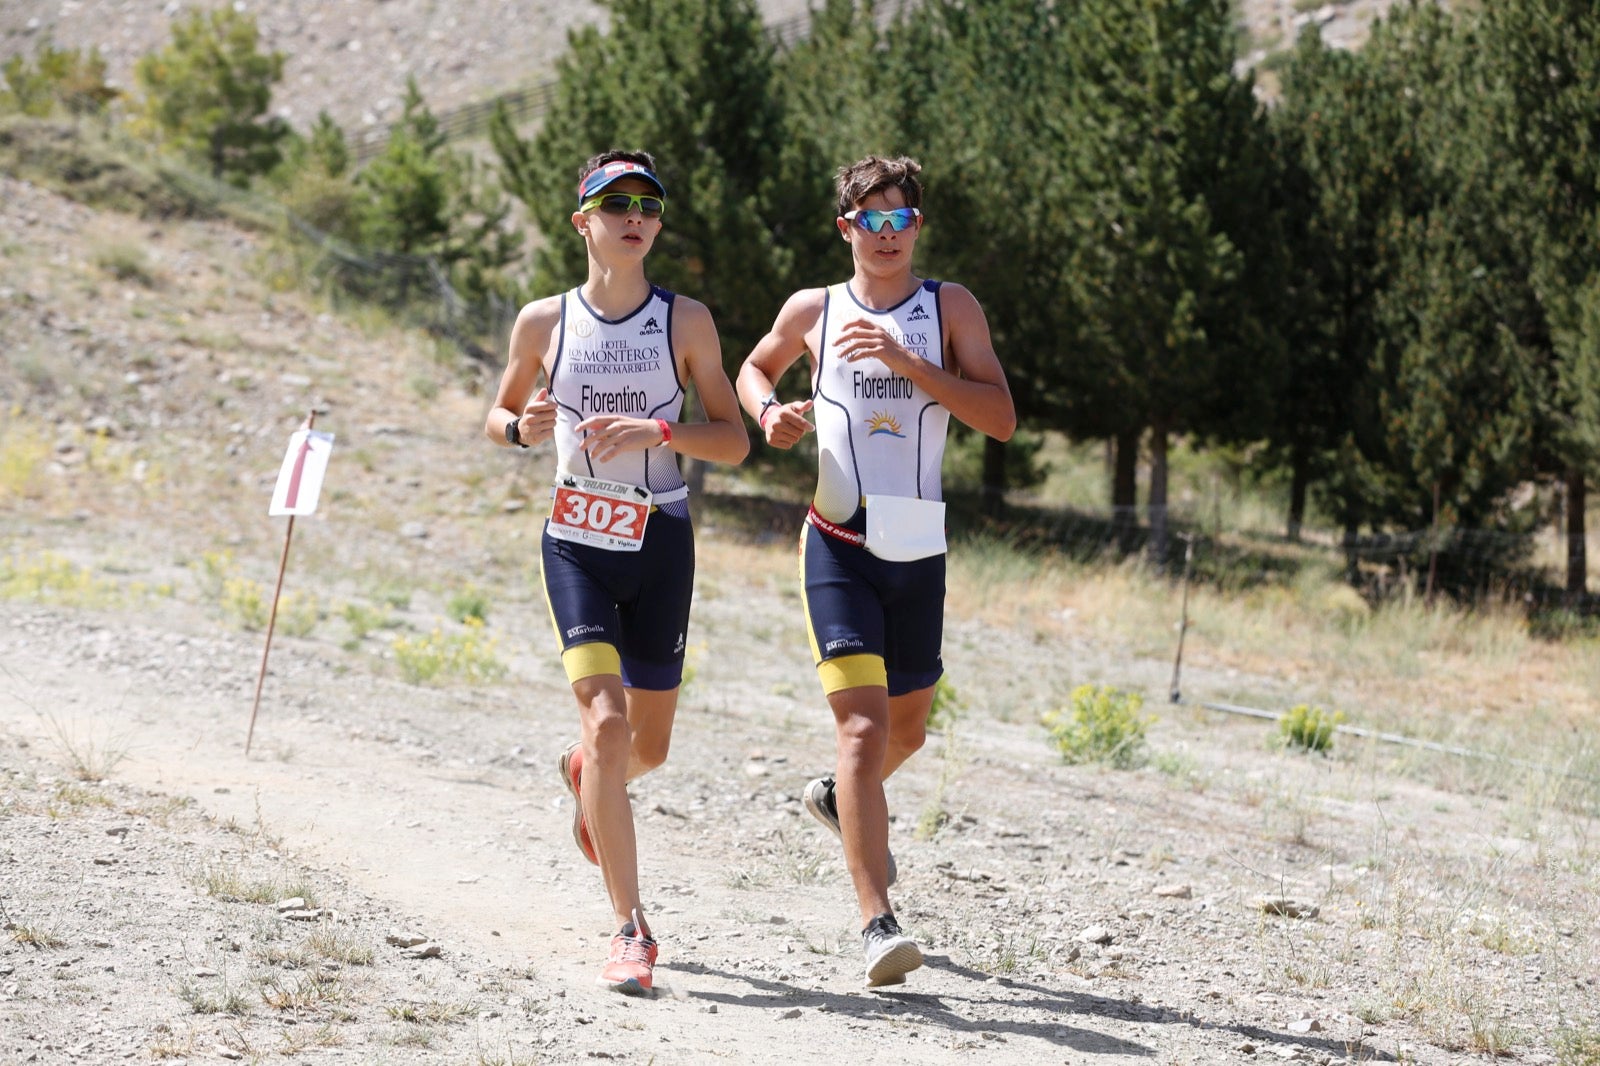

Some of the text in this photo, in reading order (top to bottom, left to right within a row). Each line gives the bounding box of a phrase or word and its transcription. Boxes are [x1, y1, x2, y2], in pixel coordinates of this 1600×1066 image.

[568, 346, 660, 363] LOS MONTEROS
[601, 339, 629, 349] HOTEL
[612, 361, 661, 374] MARBELLA
[853, 370, 914, 400] Florentino
[581, 384, 647, 413] Florentino
[563, 494, 638, 537] 302
